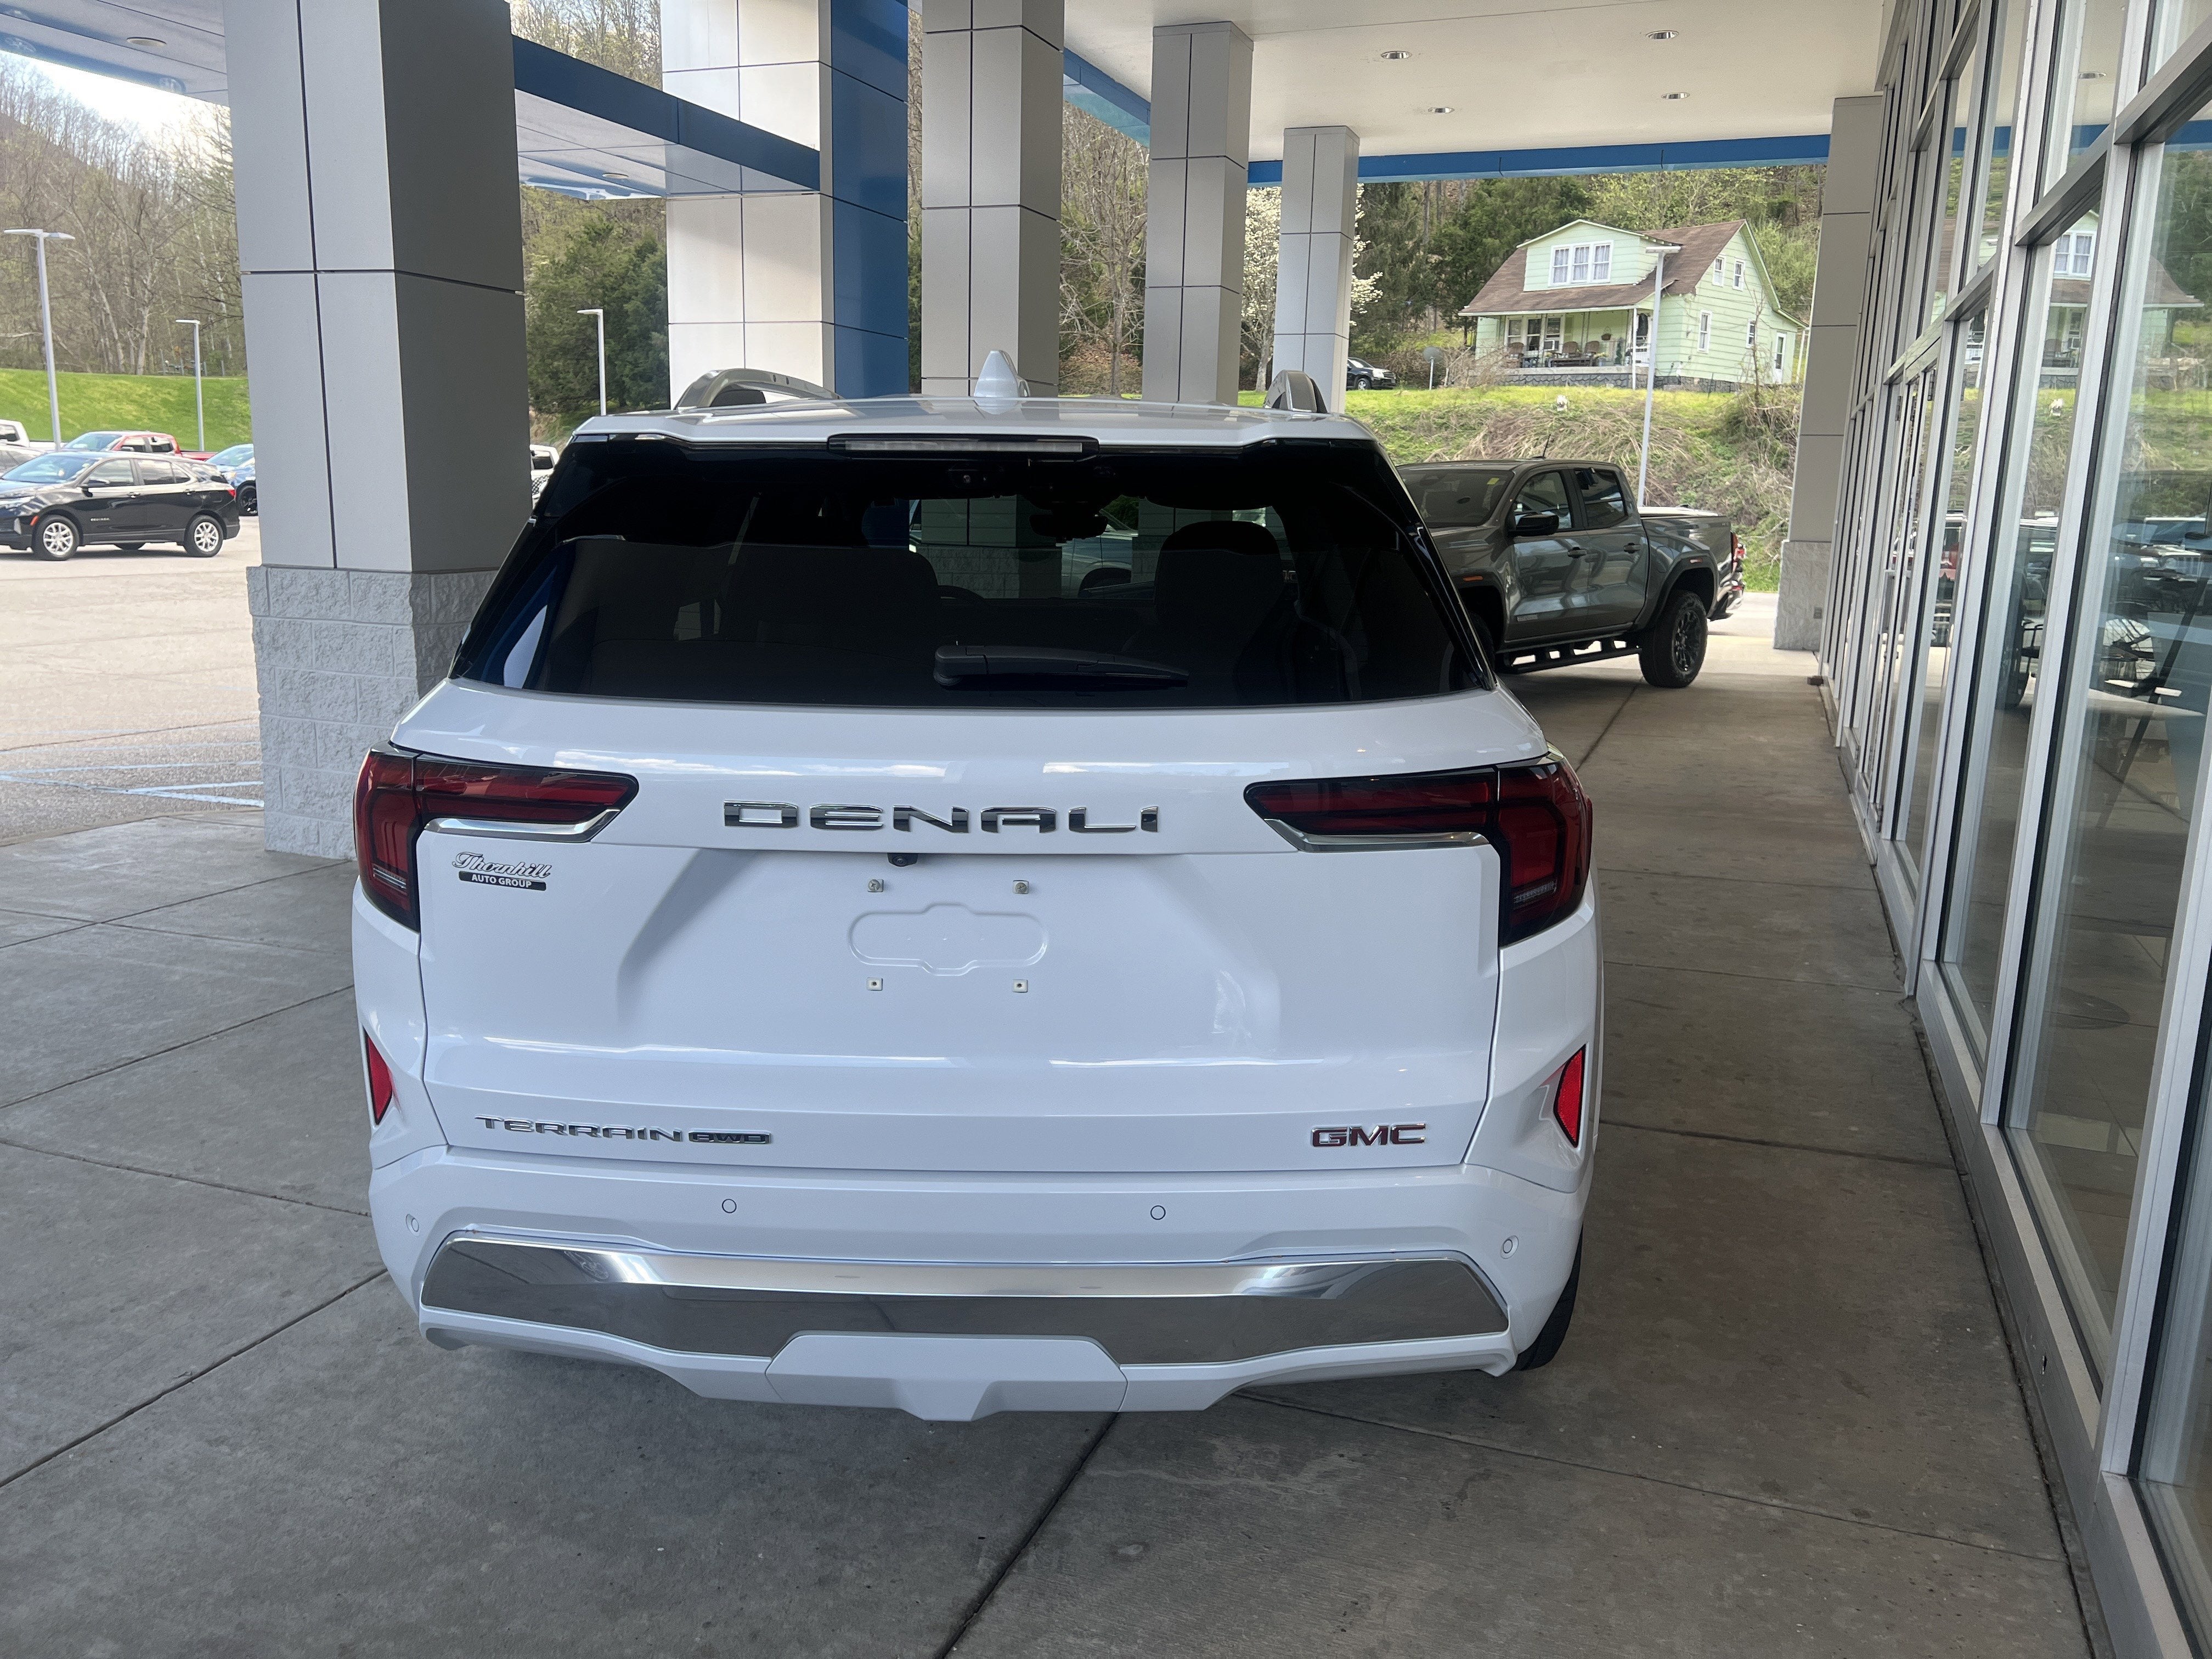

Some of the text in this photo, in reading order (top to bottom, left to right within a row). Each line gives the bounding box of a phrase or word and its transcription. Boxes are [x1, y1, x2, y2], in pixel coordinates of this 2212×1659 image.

[723, 800, 1160, 833] DENALI
[452, 851, 552, 878] Thornhill
[471, 873, 532, 888] AUTO GROUP
[475, 1115, 772, 1144] TERRAIN AWD
[1311, 1123, 1426, 1147] GMC
